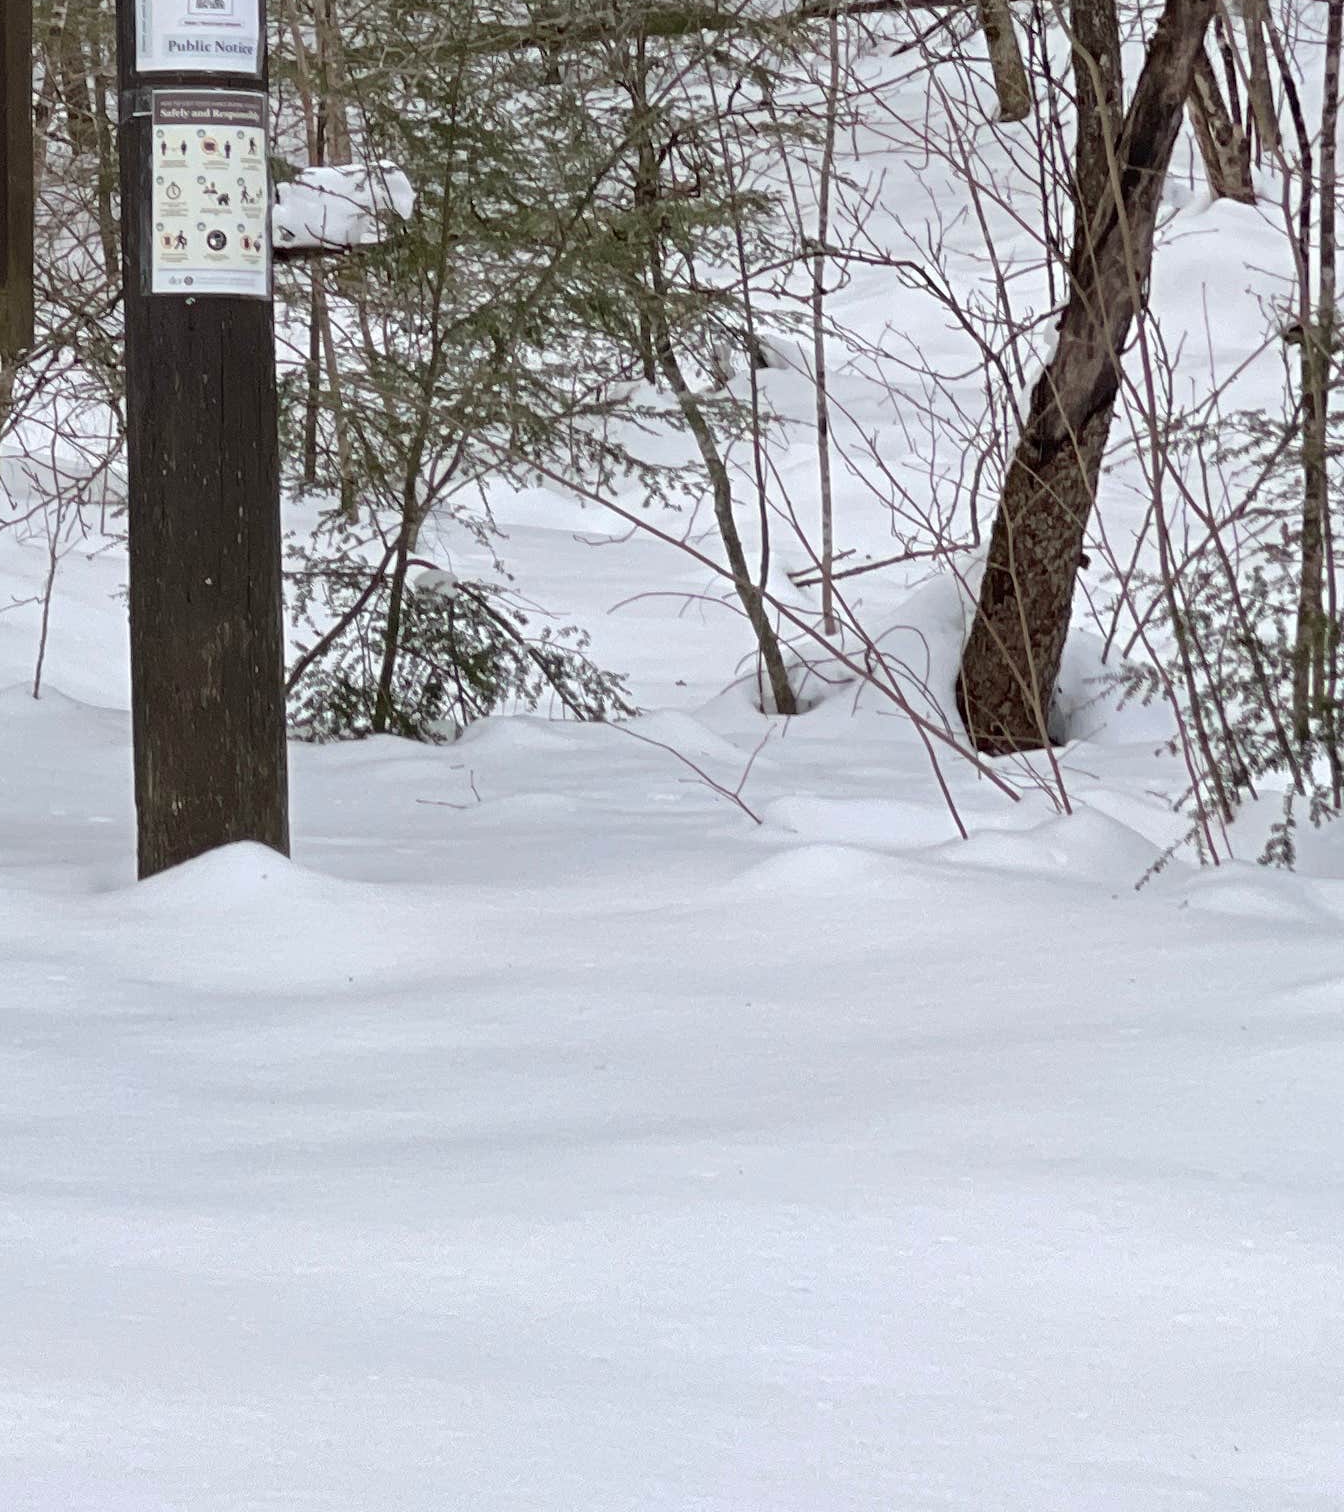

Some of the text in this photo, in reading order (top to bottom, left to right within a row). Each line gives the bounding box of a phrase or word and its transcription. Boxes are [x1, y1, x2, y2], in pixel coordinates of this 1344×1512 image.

[168, 39, 253, 55] Public Notice
[191, 108, 211, 118] and
